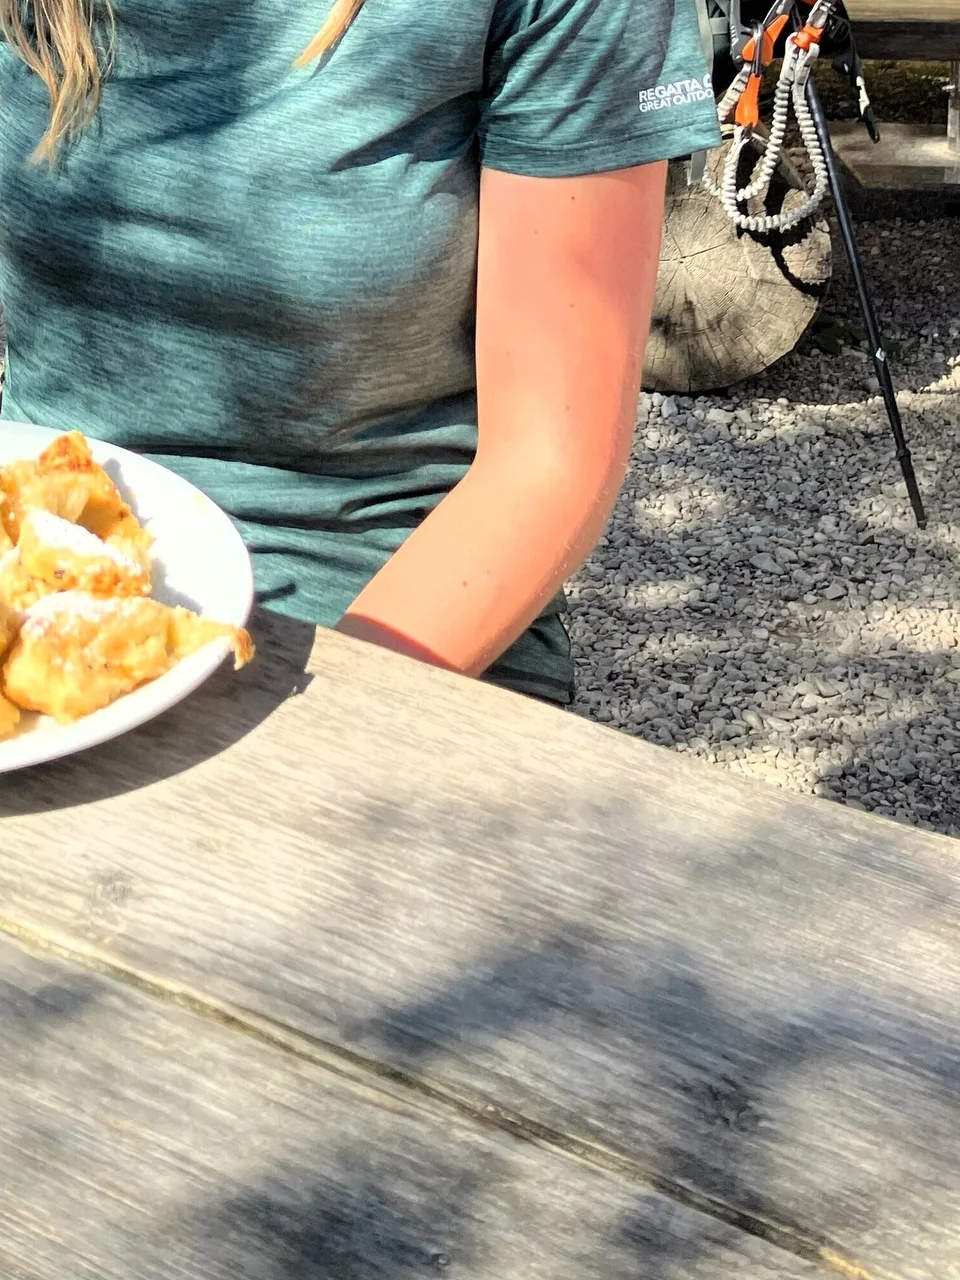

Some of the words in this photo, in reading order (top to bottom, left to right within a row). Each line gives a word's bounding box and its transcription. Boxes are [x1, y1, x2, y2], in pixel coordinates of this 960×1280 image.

[639, 78, 703, 102] REGATTA
[639, 96, 672, 113] GREAT
[672, 88, 714, 105] OUTDO
